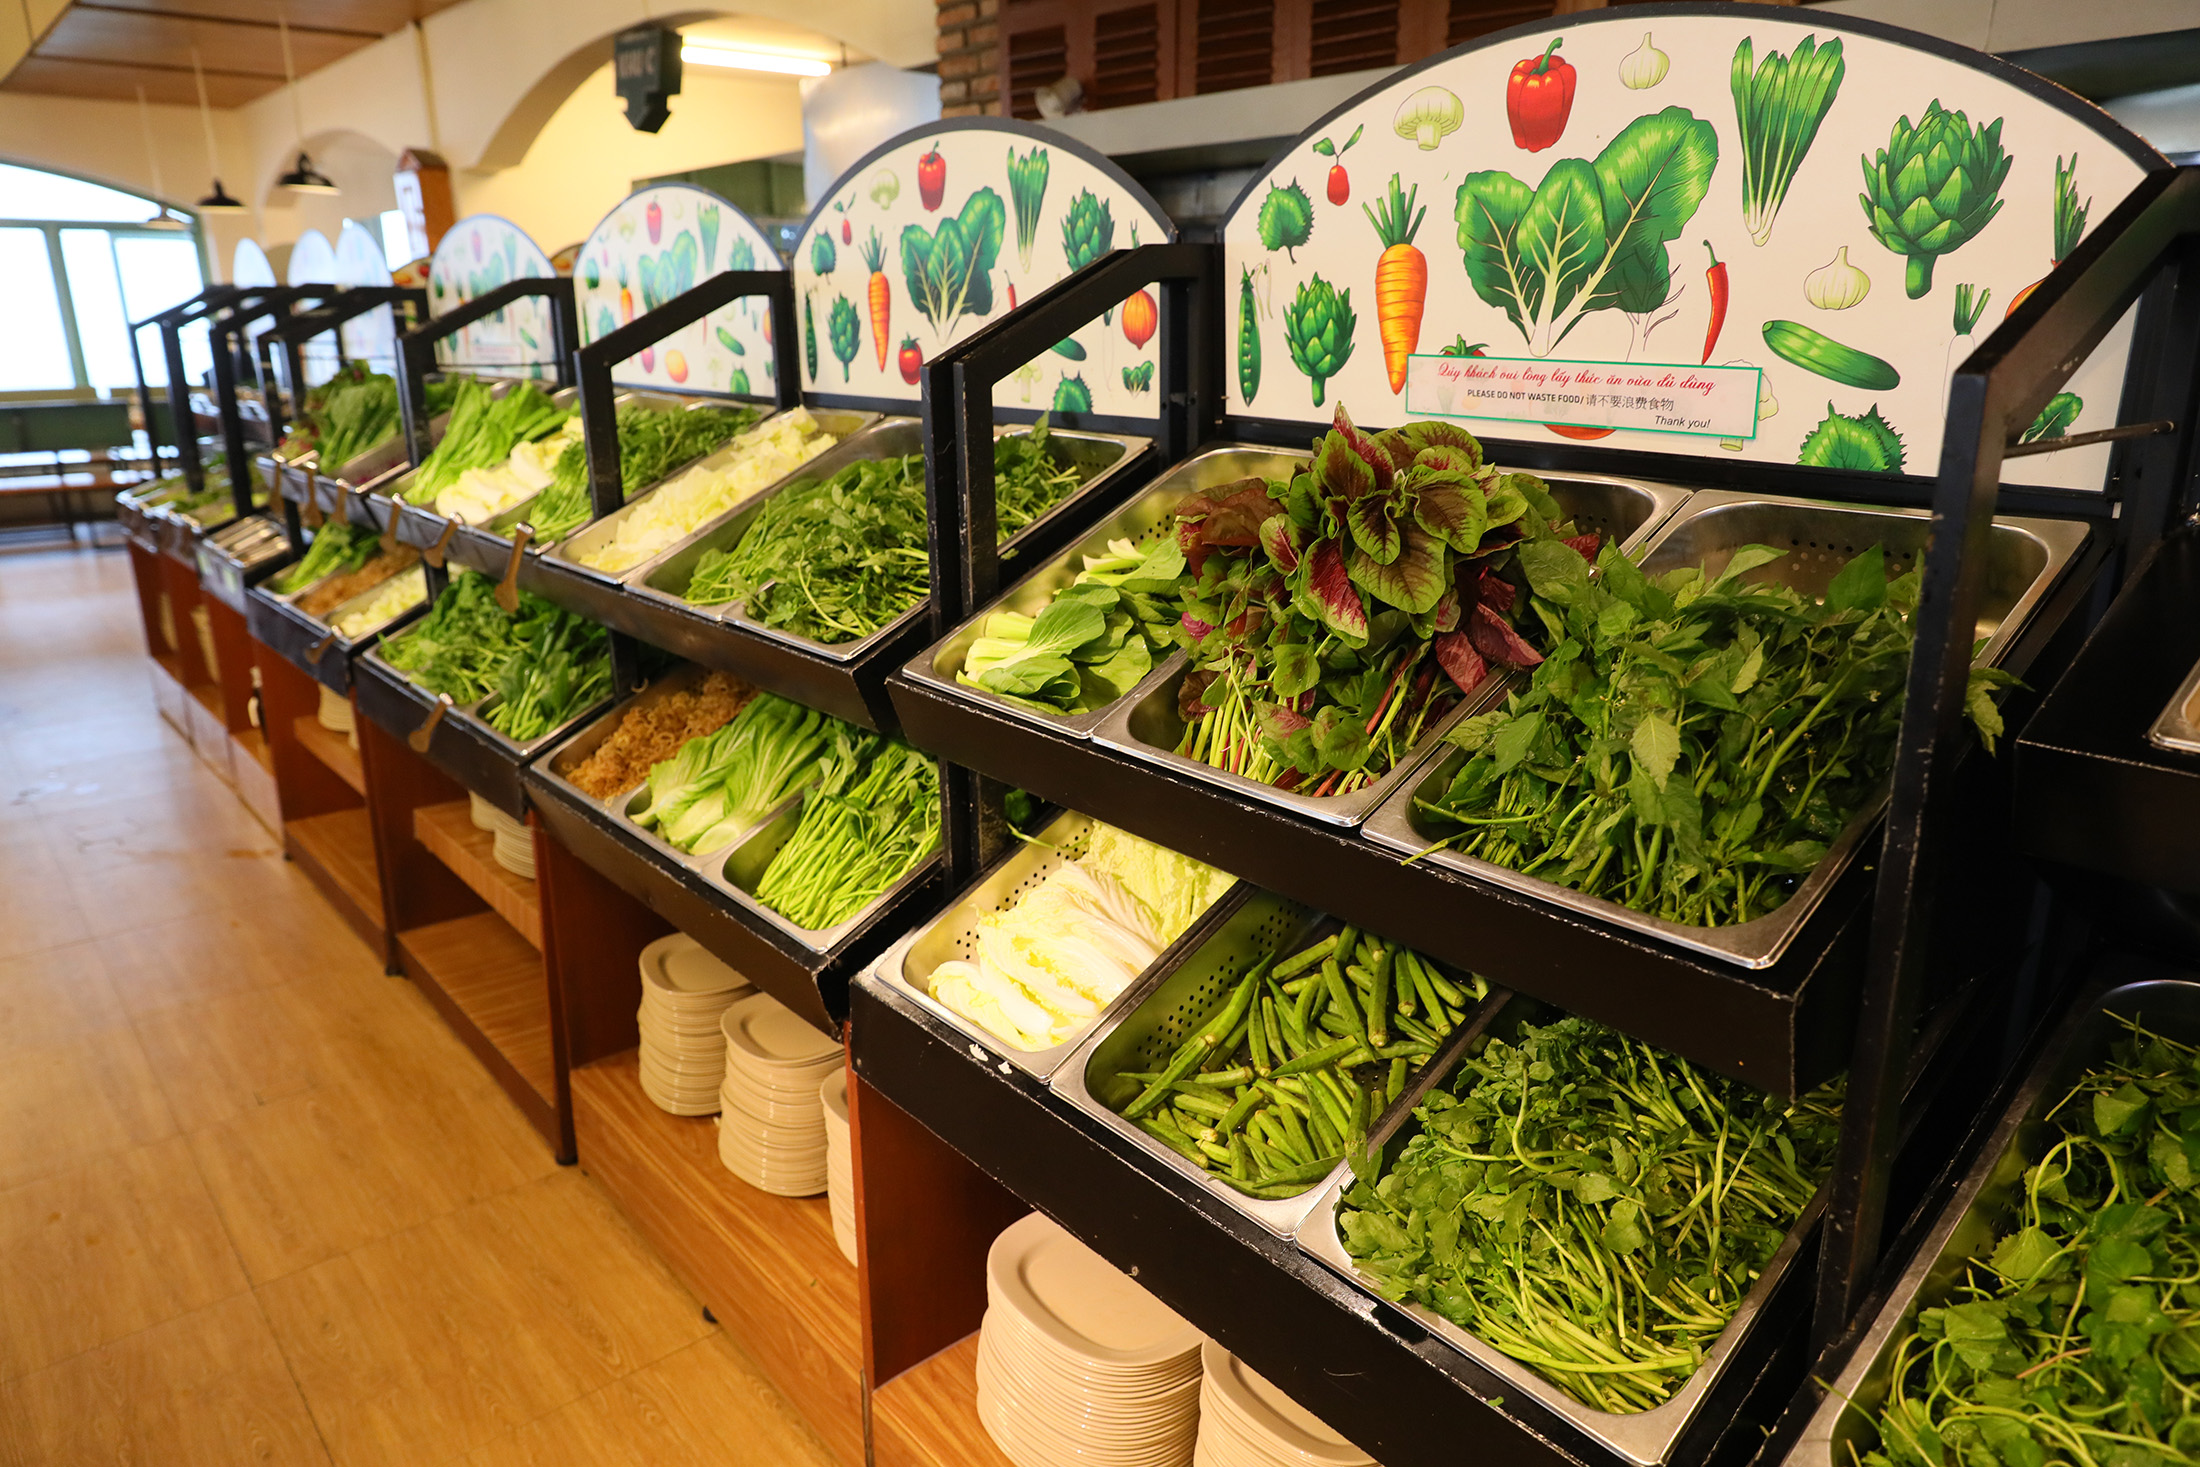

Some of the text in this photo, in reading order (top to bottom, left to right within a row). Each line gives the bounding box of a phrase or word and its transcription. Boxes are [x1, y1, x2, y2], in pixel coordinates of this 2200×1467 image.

[1438, 361, 1461, 382] Quý
[1464, 364, 1499, 379] khách
[1522, 366, 1548, 387] lòng
[1551, 367, 1572, 388] lấy
[1606, 374, 1624, 385] ăn
[1656, 373, 1679, 388] đủ
[1680, 374, 1717, 396] dùng
[1467, 389, 1674, 411] PLEASE DO NOT WASTE FOOD/ 请不要浪费食物
[1655, 415, 1711, 430] Thank you!
